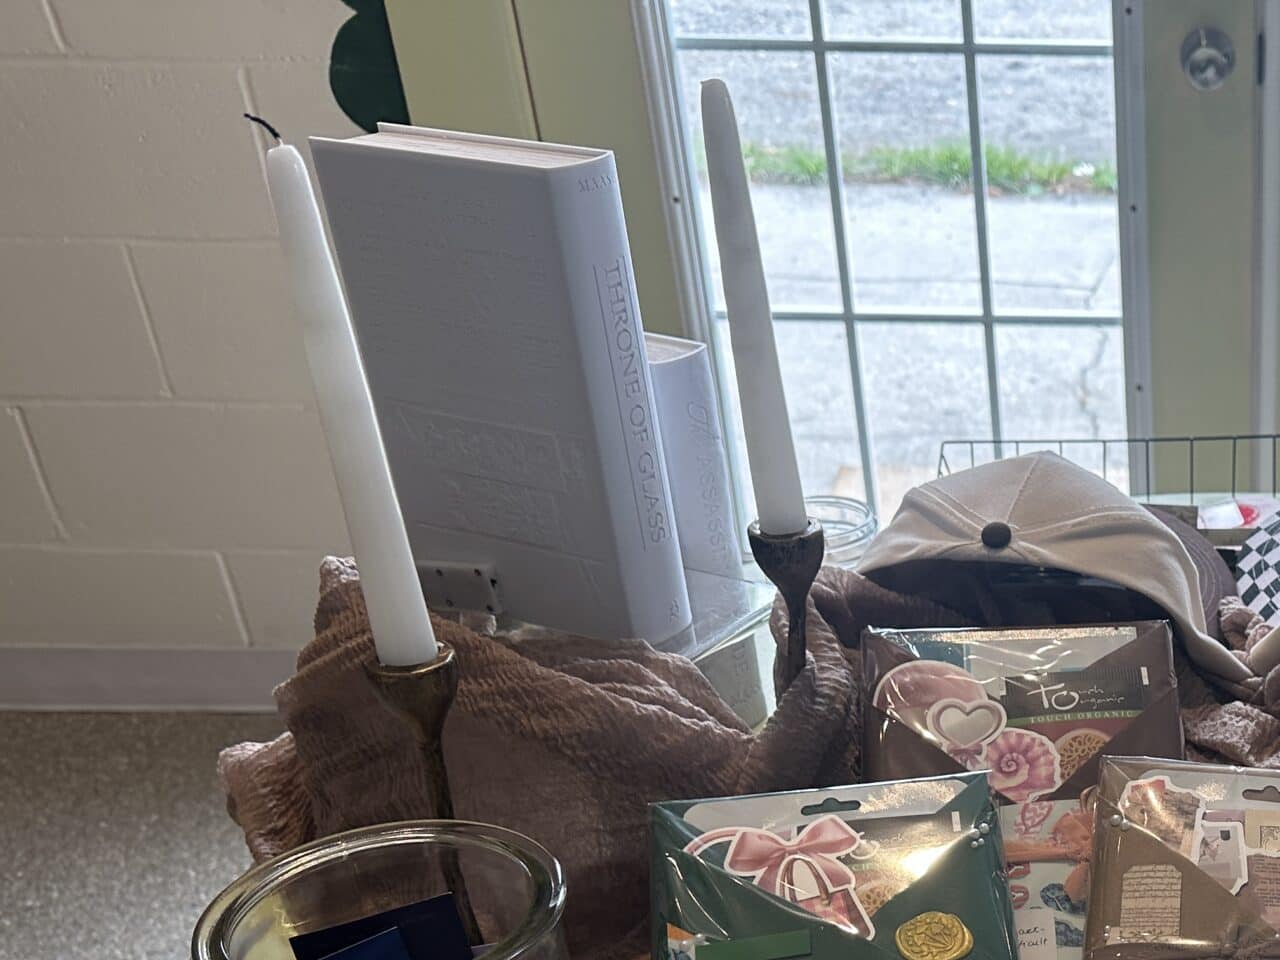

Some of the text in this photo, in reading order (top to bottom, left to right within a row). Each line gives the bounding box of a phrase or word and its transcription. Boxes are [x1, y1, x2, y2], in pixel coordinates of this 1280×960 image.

[604, 260, 666, 544] THRONE OF GLASS
[1031, 711, 1134, 723] TOUCH ORGANIC
